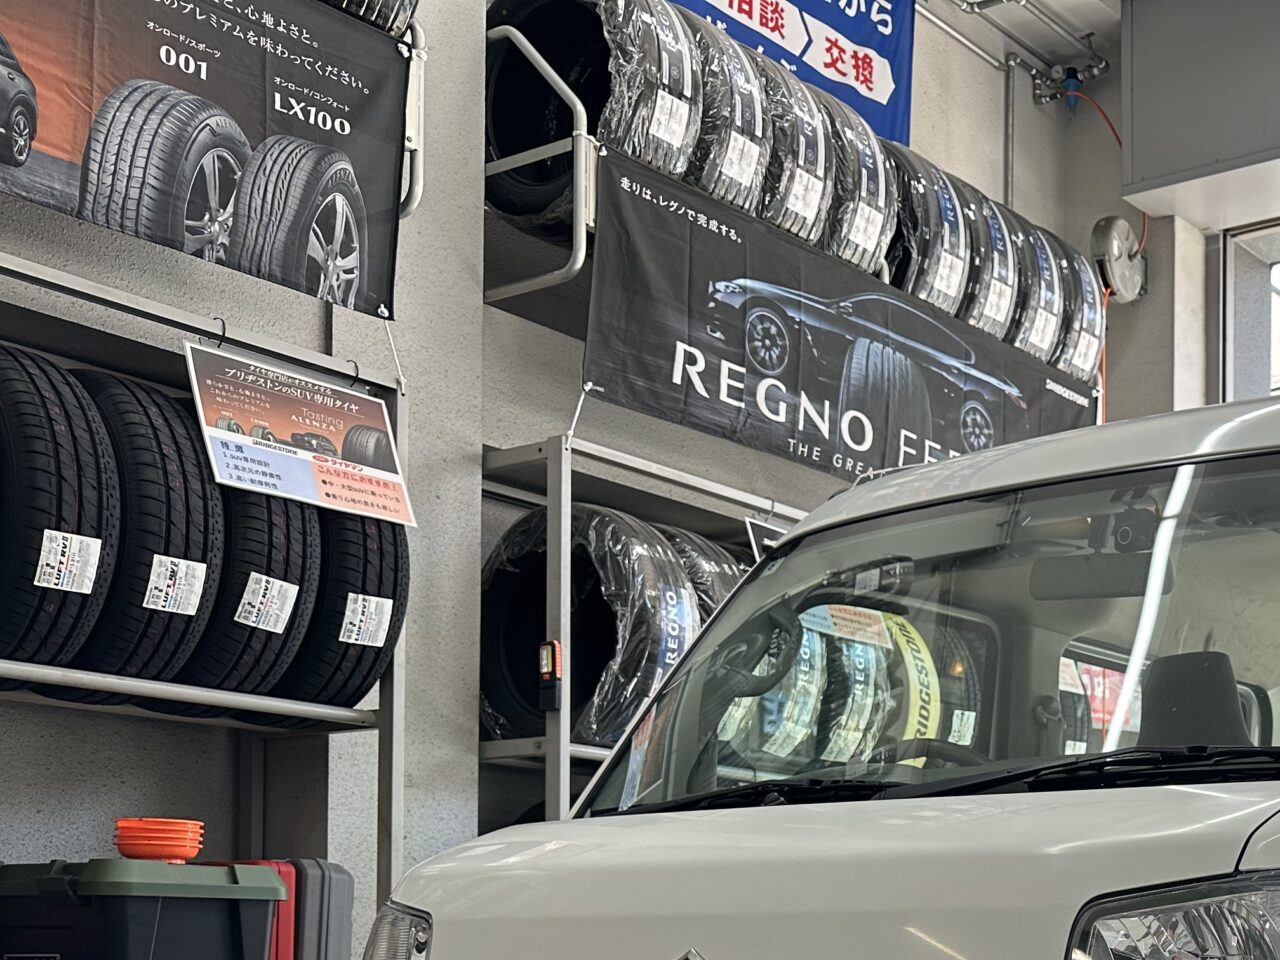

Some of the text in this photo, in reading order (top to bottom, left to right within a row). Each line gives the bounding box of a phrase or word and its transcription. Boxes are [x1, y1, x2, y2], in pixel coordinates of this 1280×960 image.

[157, 0, 370, 94] のプレミアムを味わってください。
[214, 0, 319, 48] と、心地よさと。
[159, 45, 208, 81] 001
[823, 36, 874, 92] 交換
[274, 92, 351, 135] LX100
[620, 176, 742, 244] 走りは、レグノで完成する。
[225, 367, 360, 414] ブリヂストンのSUV専用タイヤ
[672, 340, 874, 452] REGNO
[302, 407, 344, 430] Tasting
[788, 438, 886, 480] THE GREA
[664, 590, 680, 665] REGNO
[798, 628, 811, 685] REGN
[855, 643, 865, 696] REGN
